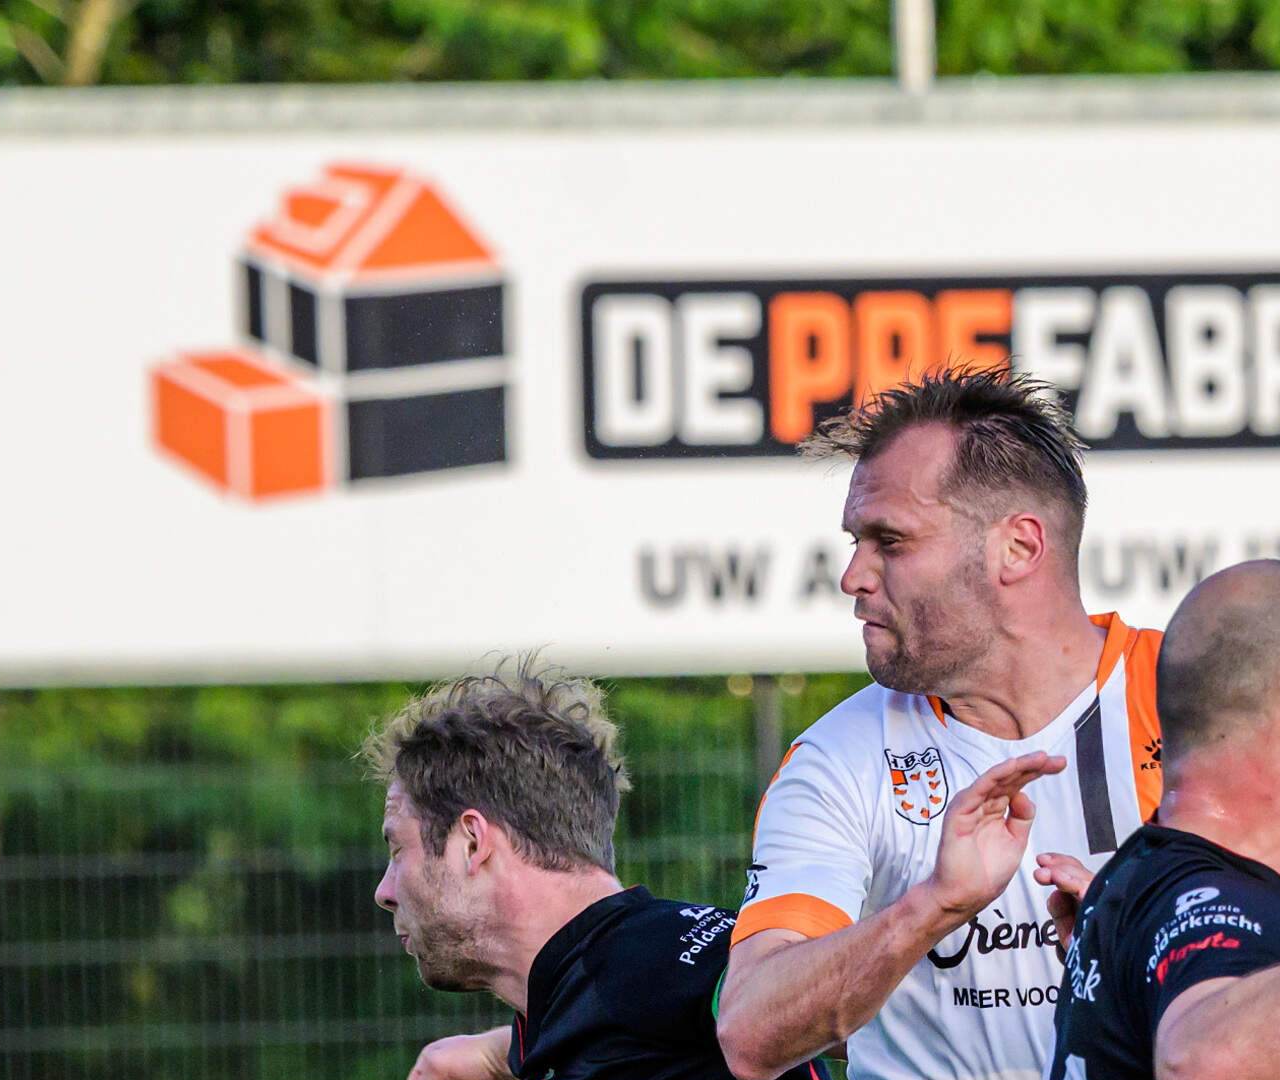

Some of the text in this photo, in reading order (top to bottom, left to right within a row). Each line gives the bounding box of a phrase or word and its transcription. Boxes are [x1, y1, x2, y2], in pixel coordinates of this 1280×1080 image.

[638, 543, 769, 605] UW
[679, 917, 737, 966] Polderk
[953, 985, 1059, 1009] MEER VOO
